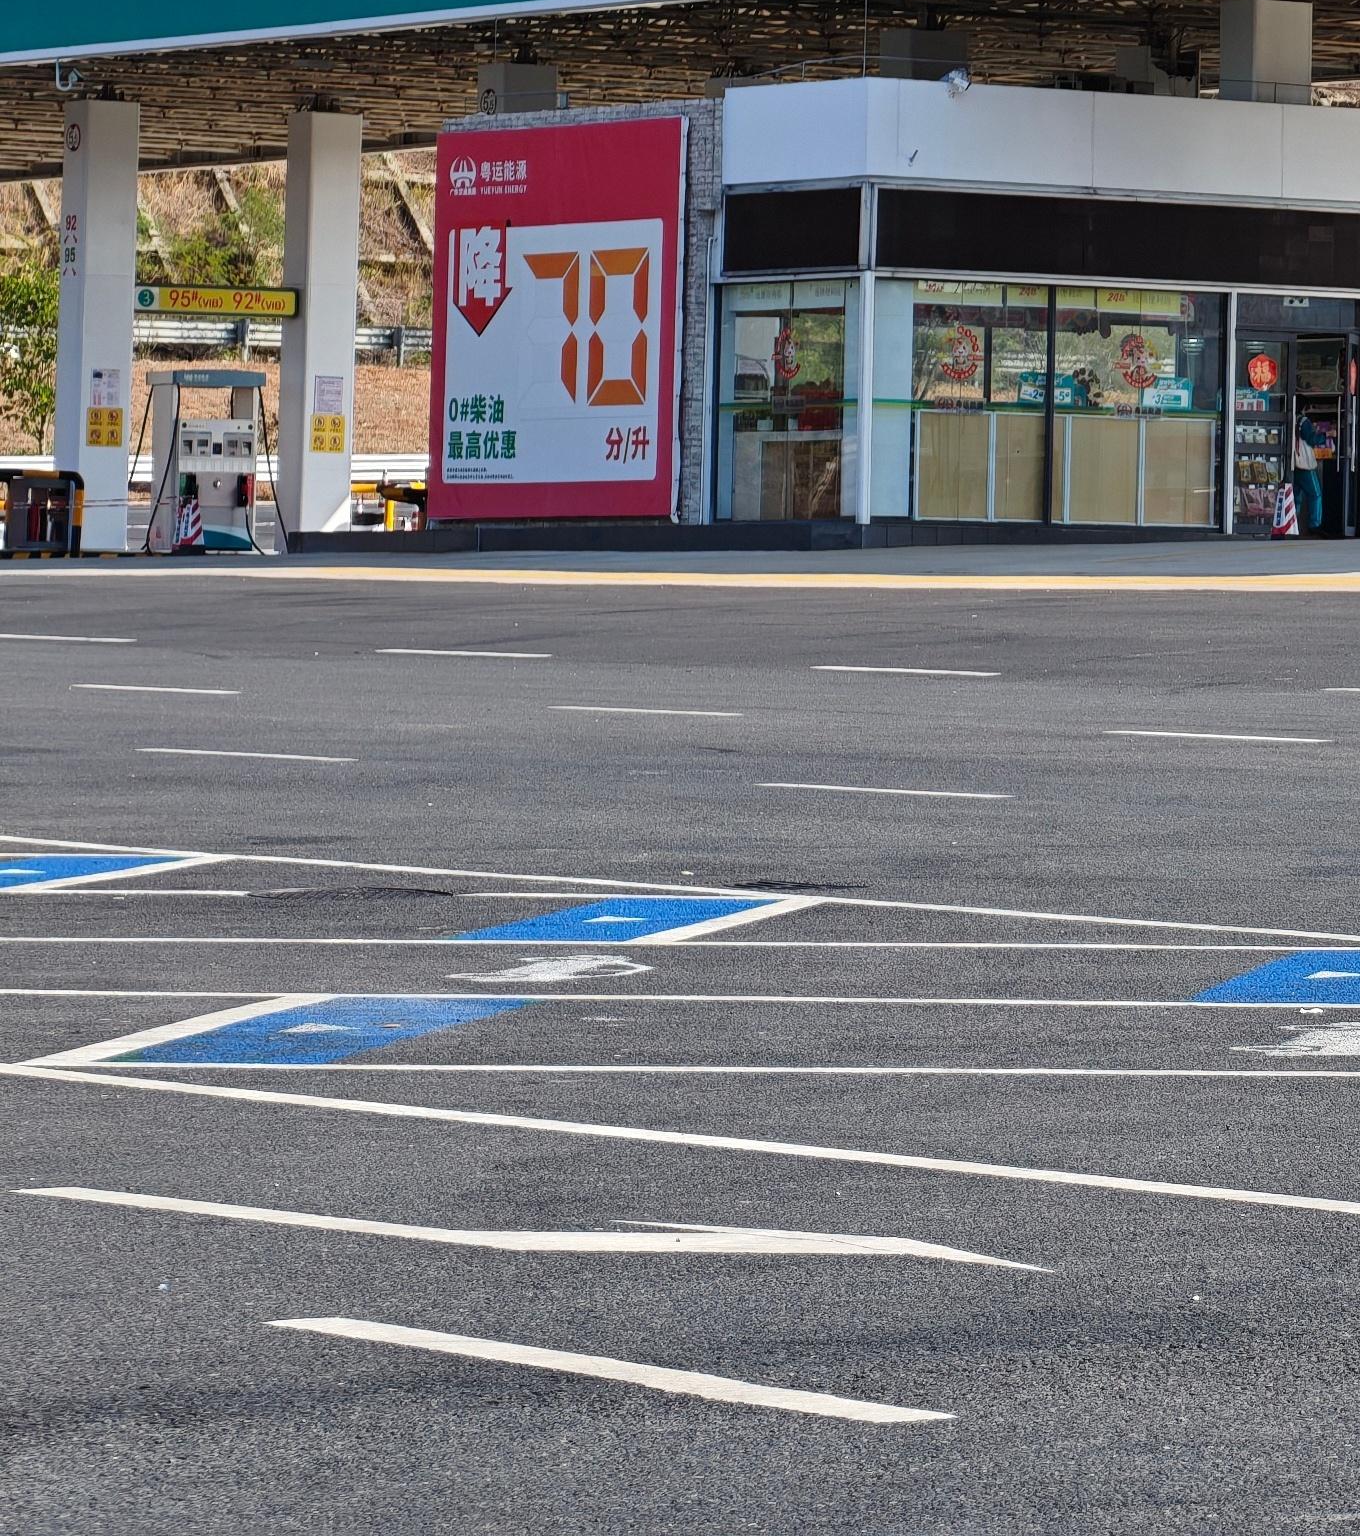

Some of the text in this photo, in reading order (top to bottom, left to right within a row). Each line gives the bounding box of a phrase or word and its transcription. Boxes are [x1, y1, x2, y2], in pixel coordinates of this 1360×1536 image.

[480, 160, 527, 182] 粤运能源
[480, 184, 527, 195] YUEYUN ENERGY
[65, 214, 77, 231] 92
[64, 247, 76, 263] 95
[459, 226, 502, 306] 降
[141, 291, 151, 305] 3
[523, 247, 650, 407] 70
[449, 394, 504, 424] 0#柴油
[448, 430, 517, 460] 最高优惠
[605, 426, 649, 464] 分/升
